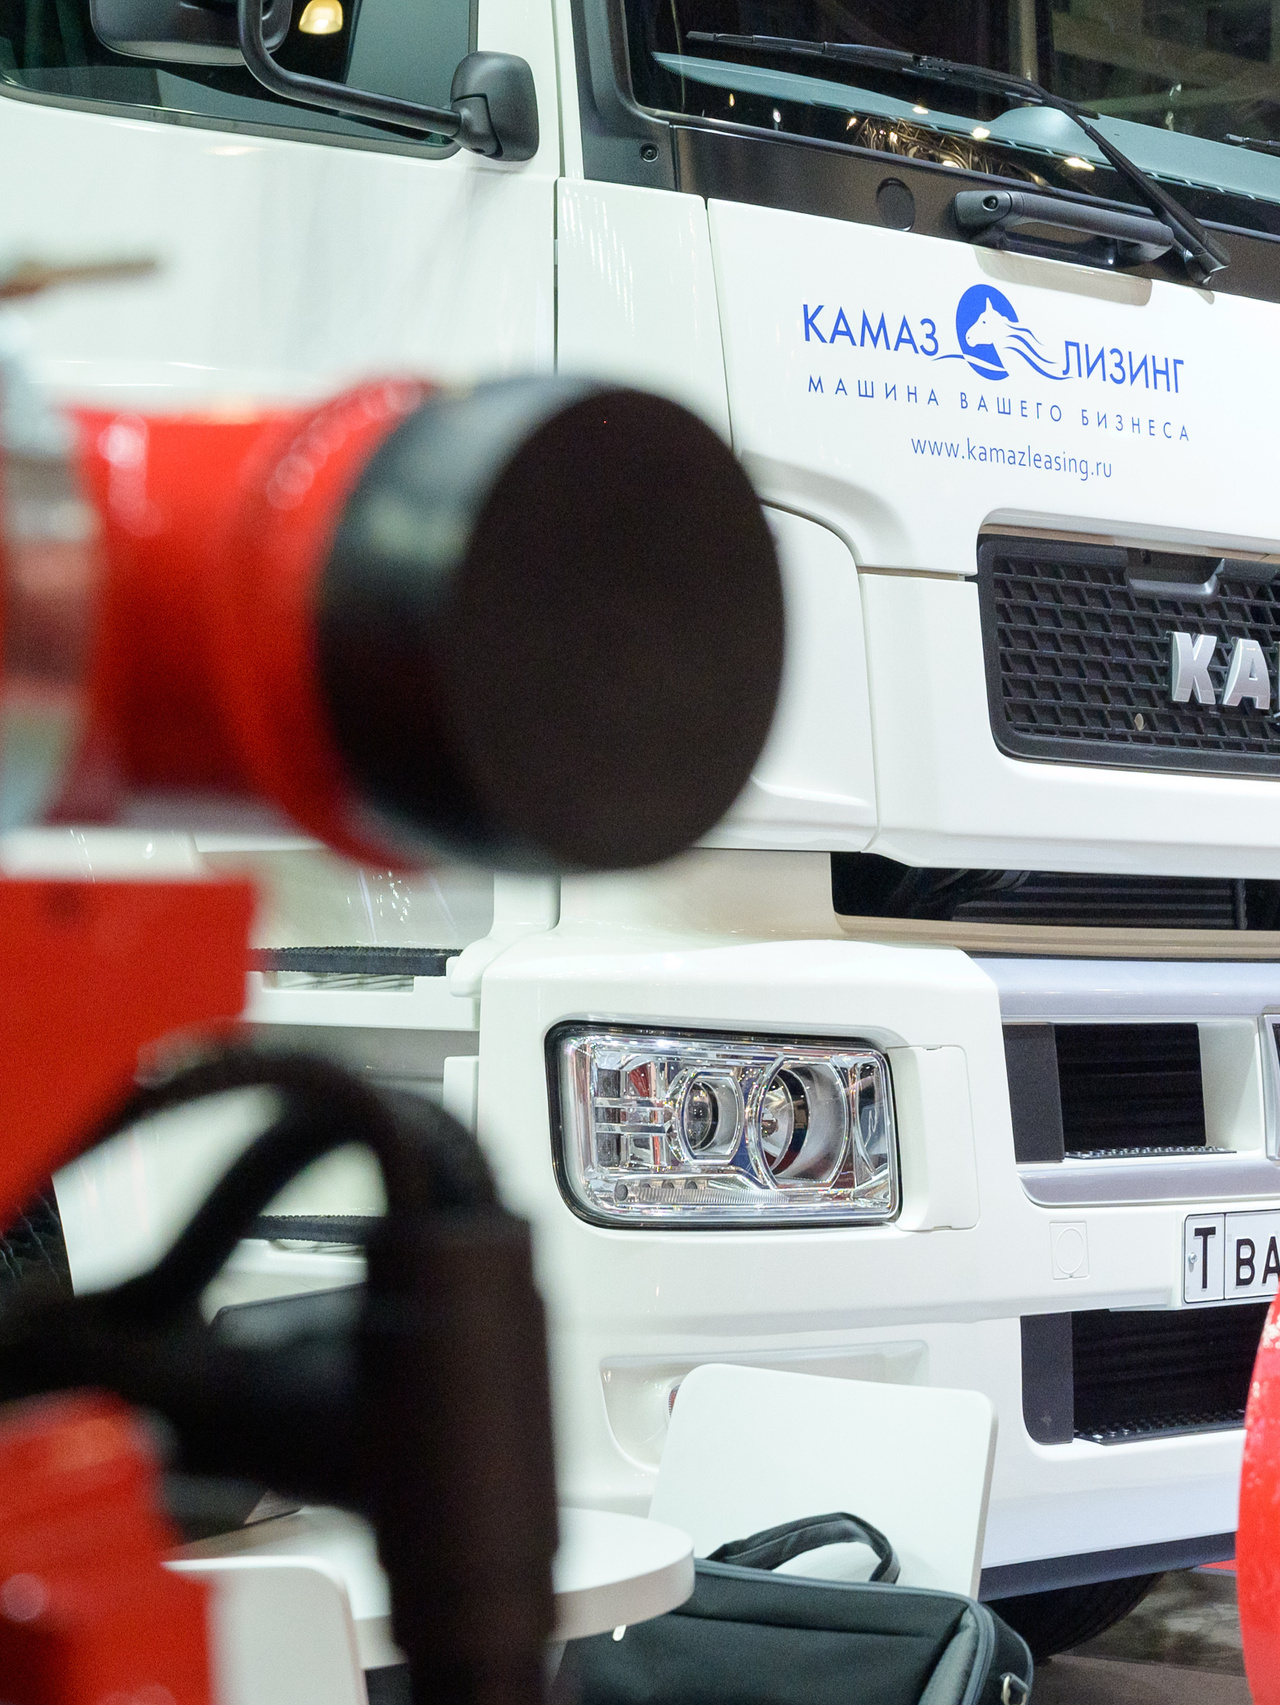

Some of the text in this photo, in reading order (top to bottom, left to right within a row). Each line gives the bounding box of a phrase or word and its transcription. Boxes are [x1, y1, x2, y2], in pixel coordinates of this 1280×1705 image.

[802, 303, 1185, 394] КАМАЗ ЛИЗИНГ
[808, 375, 1190, 442] МАШИНА ВАШЕГО БИЗНЕСА
[911, 436, 1113, 481] www.kamazleasing.ru
